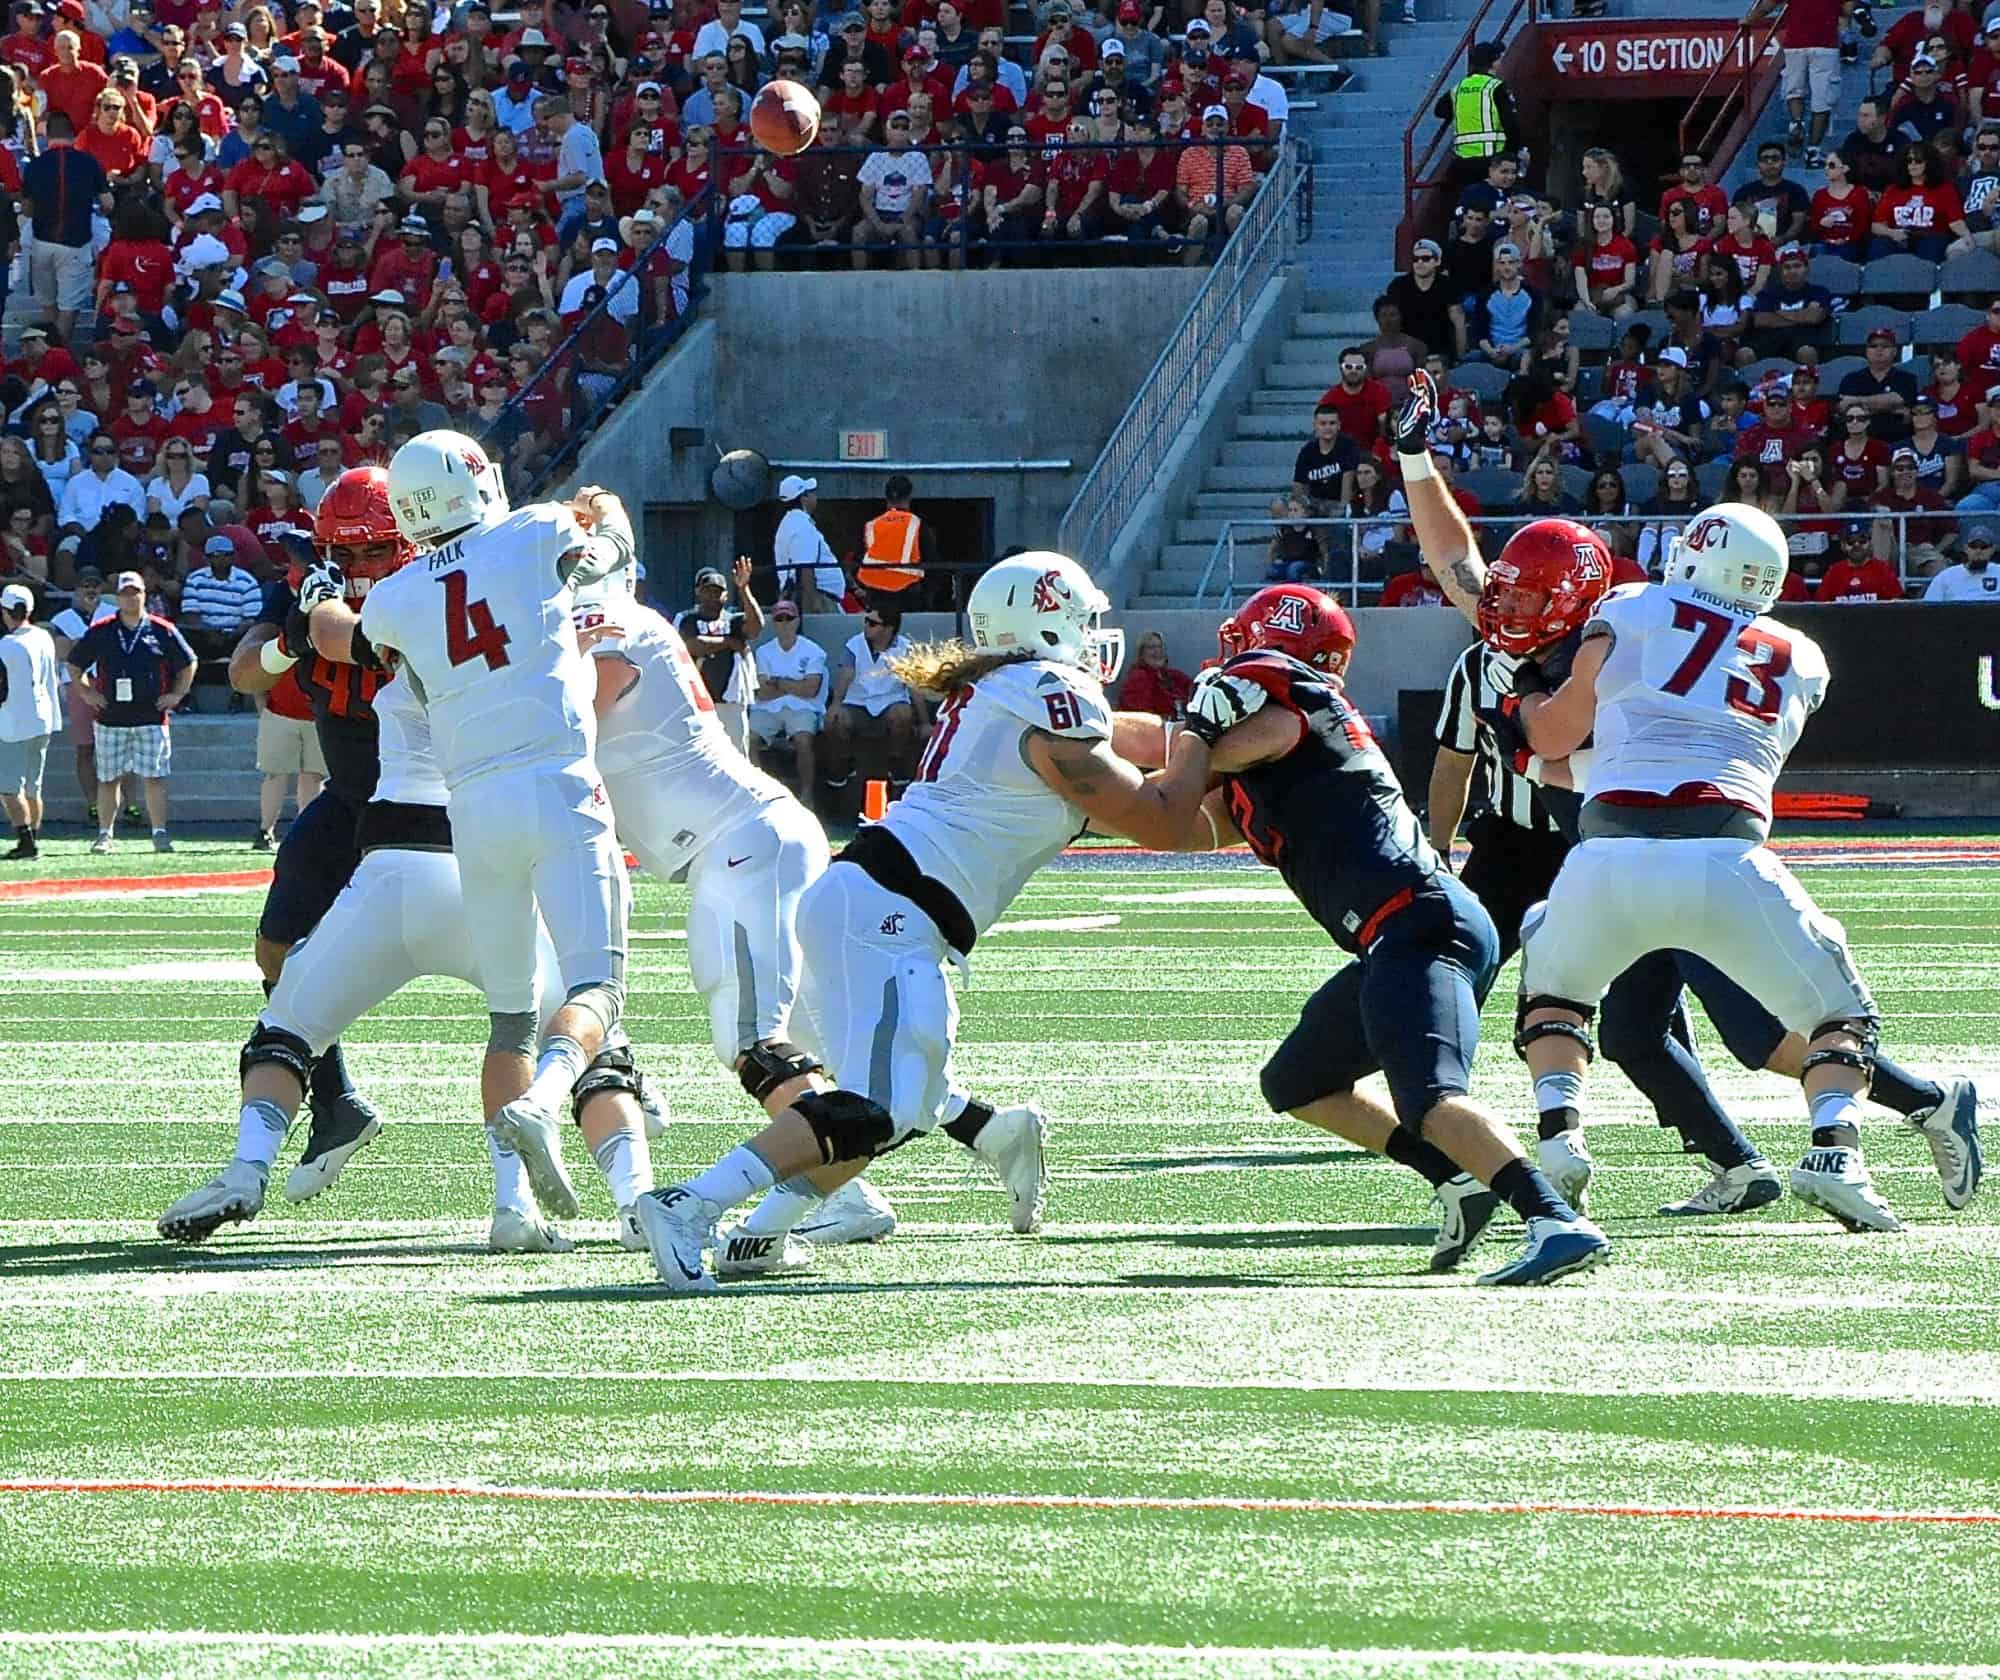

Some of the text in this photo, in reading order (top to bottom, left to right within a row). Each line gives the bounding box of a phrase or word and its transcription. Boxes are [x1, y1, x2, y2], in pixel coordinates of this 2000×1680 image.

[1578, 40, 1606, 73] 10
[1616, 37, 1724, 72] SECTION
[847, 433, 877, 457] EXIT
[420, 505, 430, 520] 4
[428, 540, 465, 572] FALK
[1571, 543, 1602, 581] A
[1760, 580, 1775, 596] 73
[434, 569, 512, 672] 4
[1264, 595, 1307, 634] A
[1656, 597, 1792, 725] 73
[1041, 690, 1082, 731] 61
[1800, 1151, 1849, 1174] NIKE
[726, 1236, 777, 1261] NIKE
